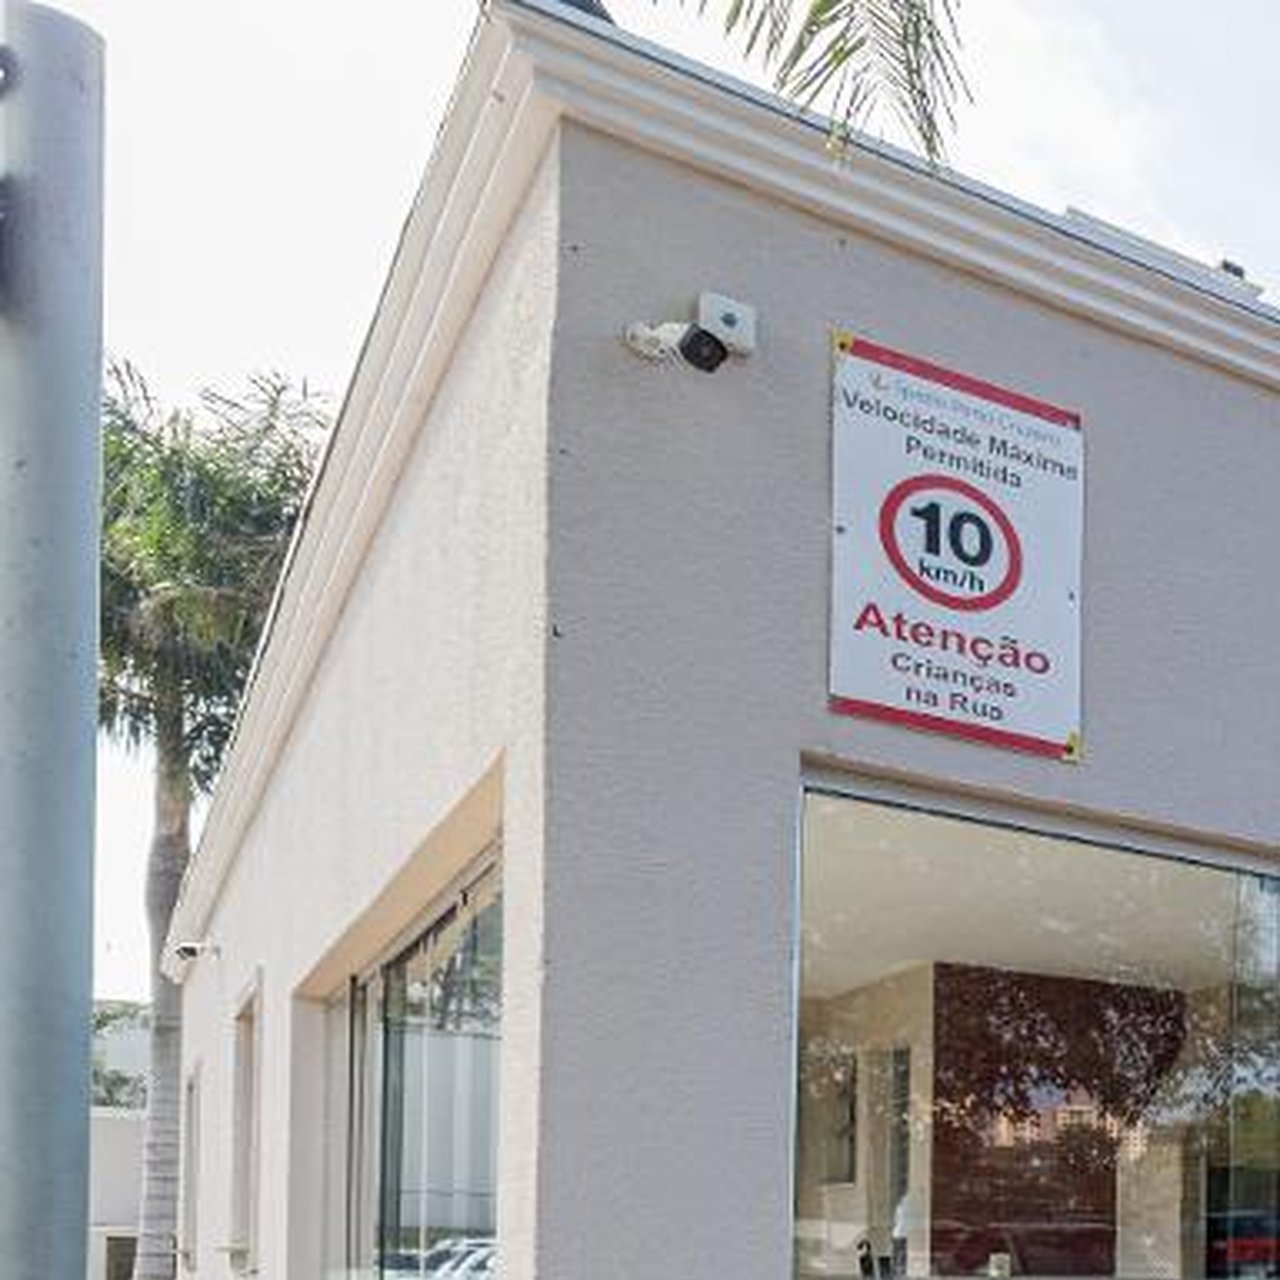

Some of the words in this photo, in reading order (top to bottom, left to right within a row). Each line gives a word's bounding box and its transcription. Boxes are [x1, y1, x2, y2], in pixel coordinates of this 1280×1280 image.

[842, 388, 981, 446] Velocidade
[905, 435, 1020, 488] Permitida
[910, 502, 993, 566] 10
[919, 558, 984, 592] km/h
[854, 602, 1051, 674] Atenção
[891, 652, 1016, 697] Crianças
[906, 686, 938, 708] na
[950, 692, 1004, 721] Rua
